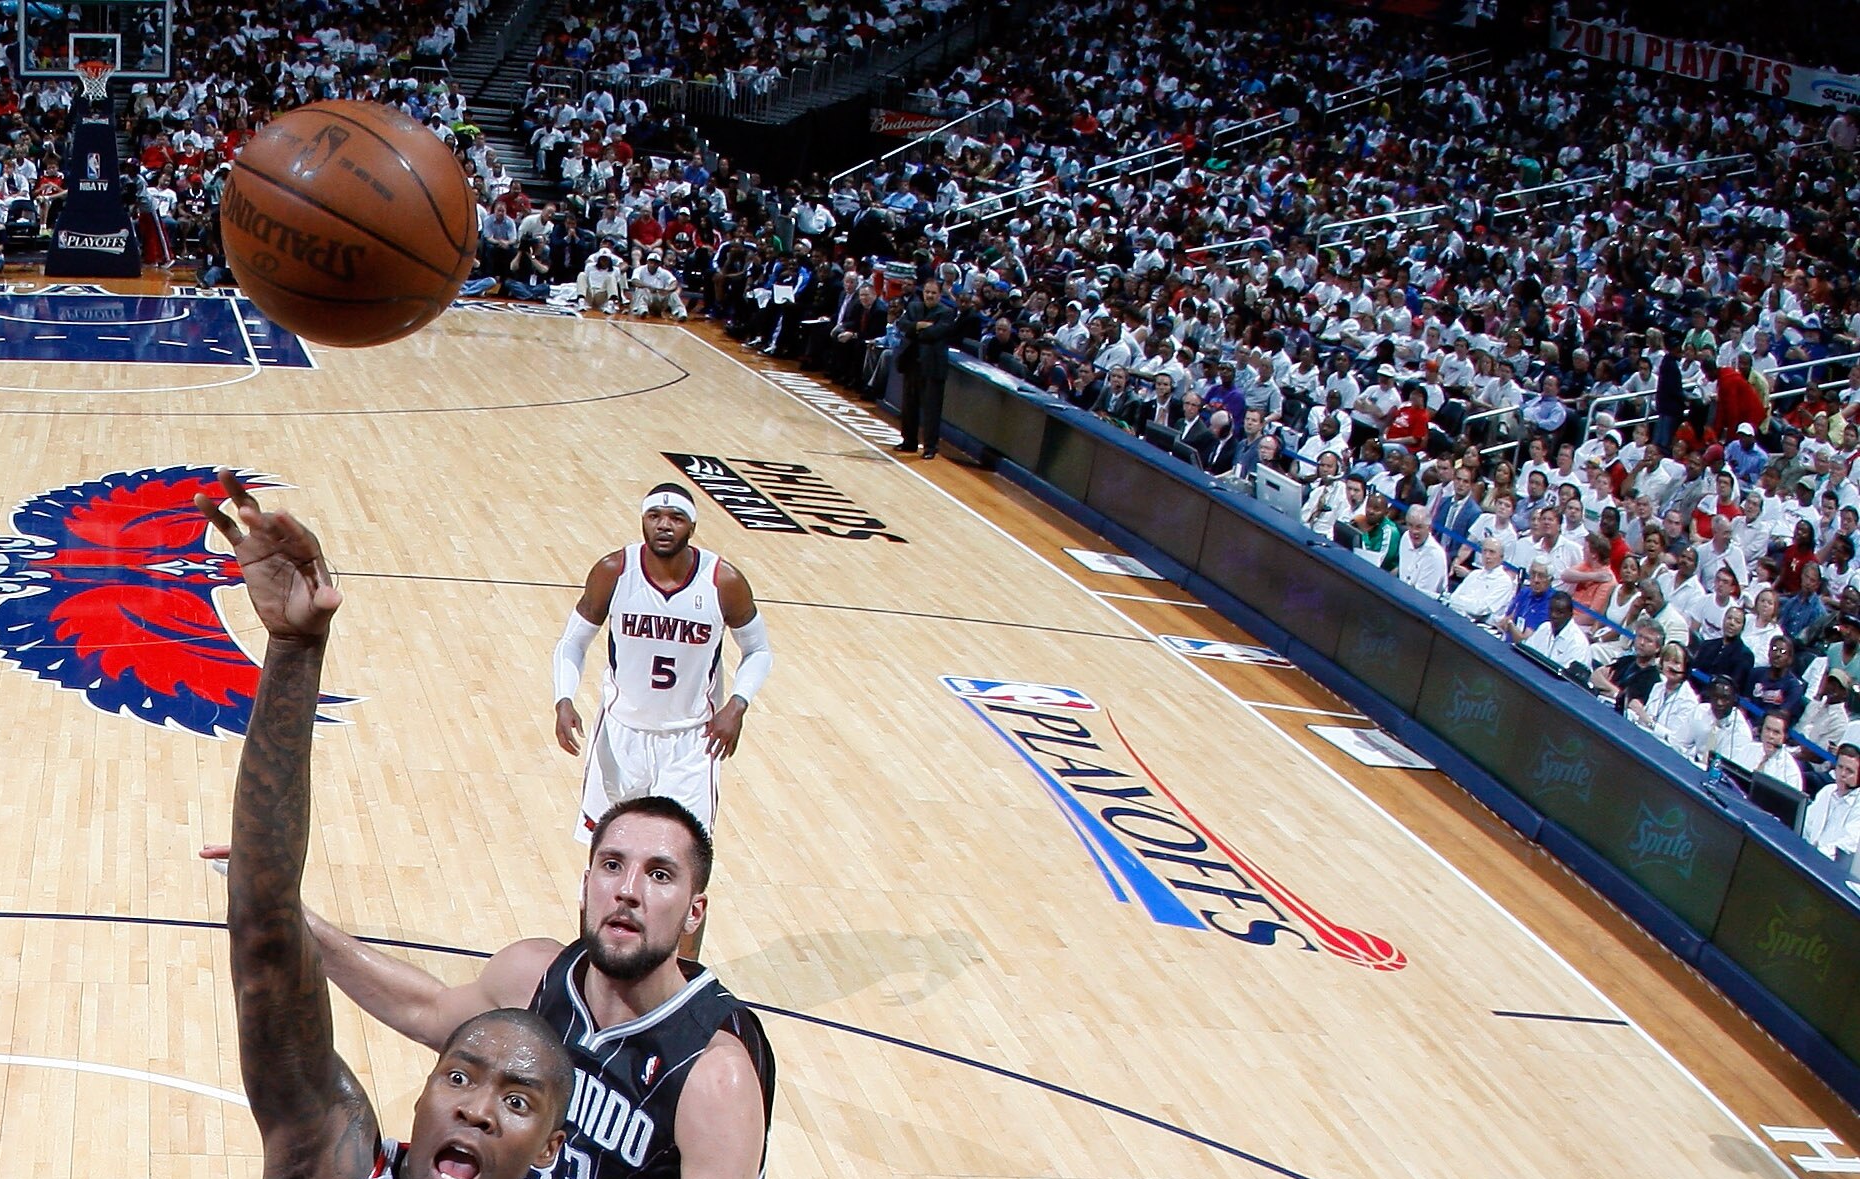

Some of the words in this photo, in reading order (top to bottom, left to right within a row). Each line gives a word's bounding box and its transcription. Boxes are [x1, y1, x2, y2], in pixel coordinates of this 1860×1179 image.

[1562, 19, 1636, 63] 2011
[870, 116, 946, 132] Budweiser
[80, 182, 96, 191] NBA
[97, 182, 108, 191] TV
[67, 236, 126, 248] PLAYOFFS
[226, 177, 366, 282] SPALDING
[686, 471, 796, 529] ARENA
[726, 457, 909, 544] PHILIPS
[621, 613, 712, 645] HAWKS
[651, 655, 677, 690] 5
[1447, 687, 1498, 724] Sprite
[1532, 745, 1592, 788] Sprite
[985, 704, 1319, 953] PLAYOFFS
[1629, 819, 1693, 866] Sprite
[1756, 917, 1830, 967] Sprite
